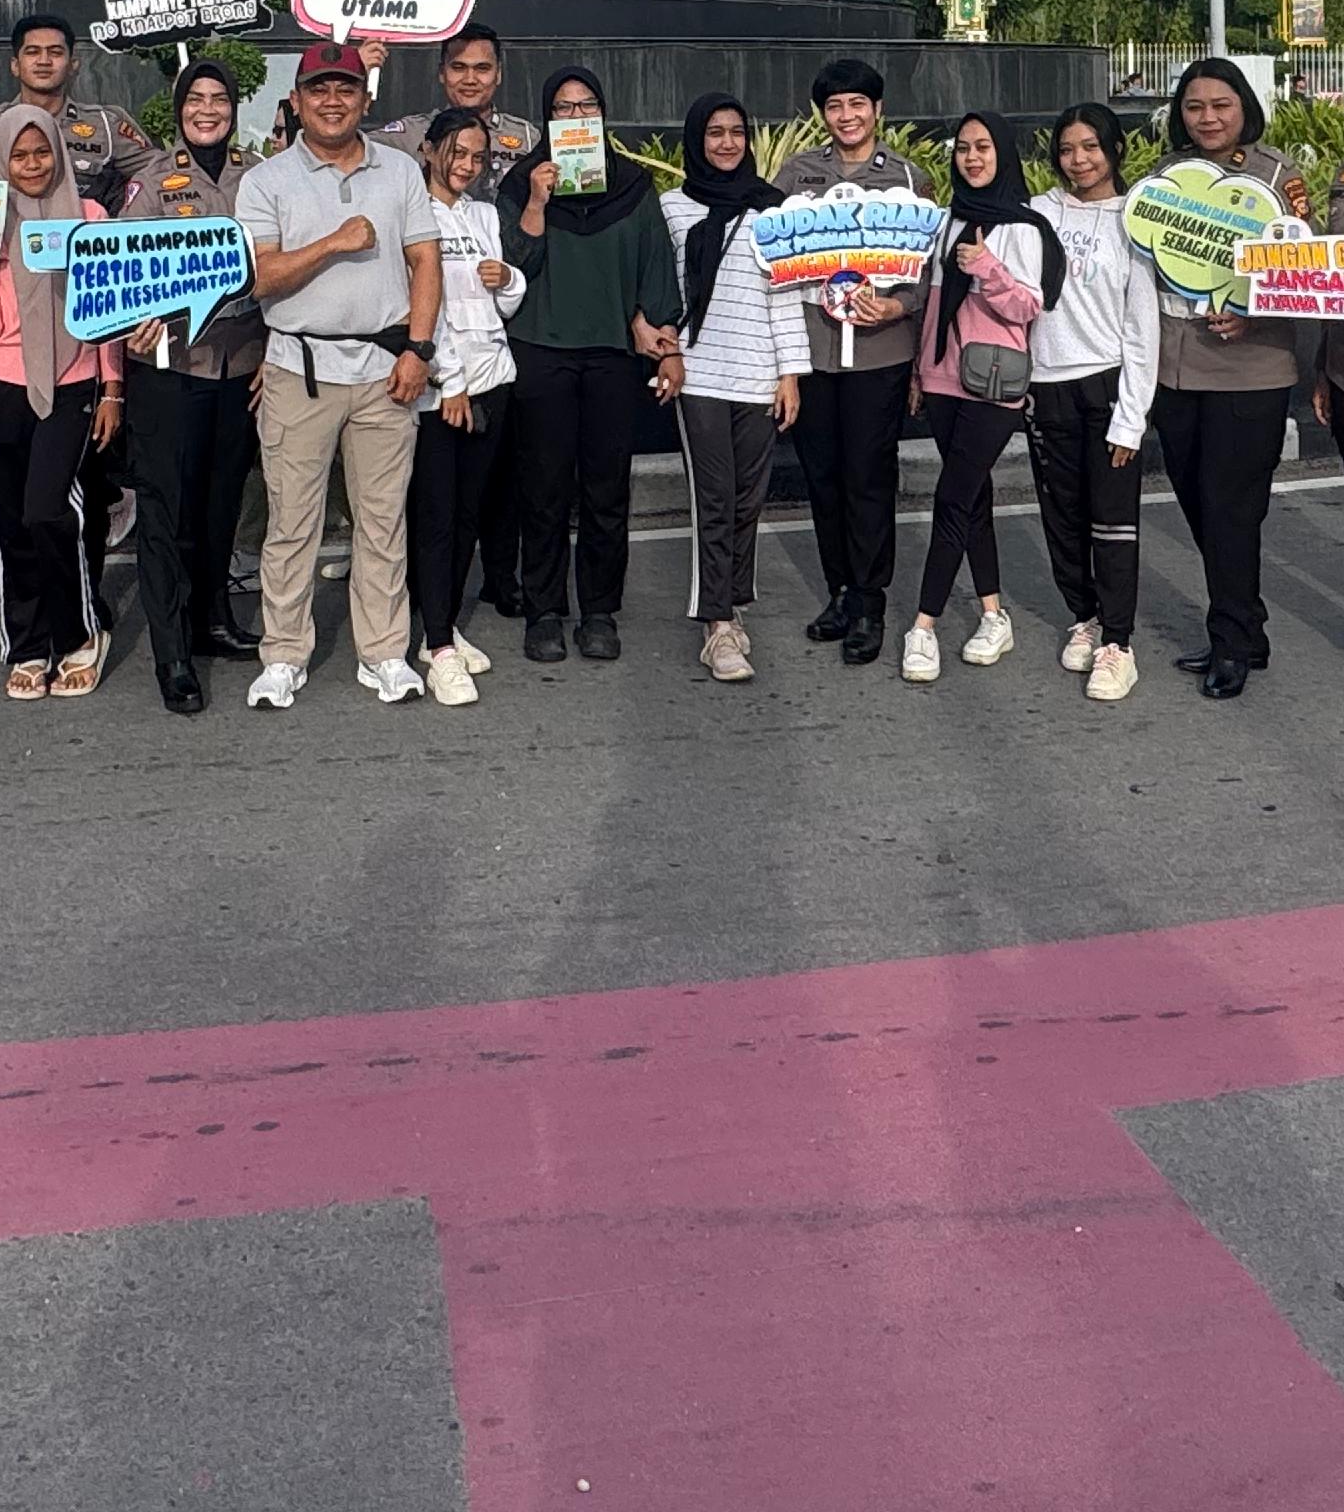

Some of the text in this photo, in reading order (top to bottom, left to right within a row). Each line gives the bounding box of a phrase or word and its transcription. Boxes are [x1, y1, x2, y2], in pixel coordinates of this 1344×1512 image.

[753, 201, 947, 245] BUDAK RIAU
[1132, 200, 1208, 238] BUDAYAKAN
[74, 226, 238, 258] MAU KAMPANYE
[1160, 231, 1215, 261] SEBAGAI
[1238, 240, 1329, 272] JANGAN
[72, 249, 241, 290] TERTIB DI JALAN
[770, 252, 924, 285] JANGAN NGEBUT
[72, 269, 243, 322] JAGA KESELAMATAN
[1255, 293, 1320, 313] NYAWA
